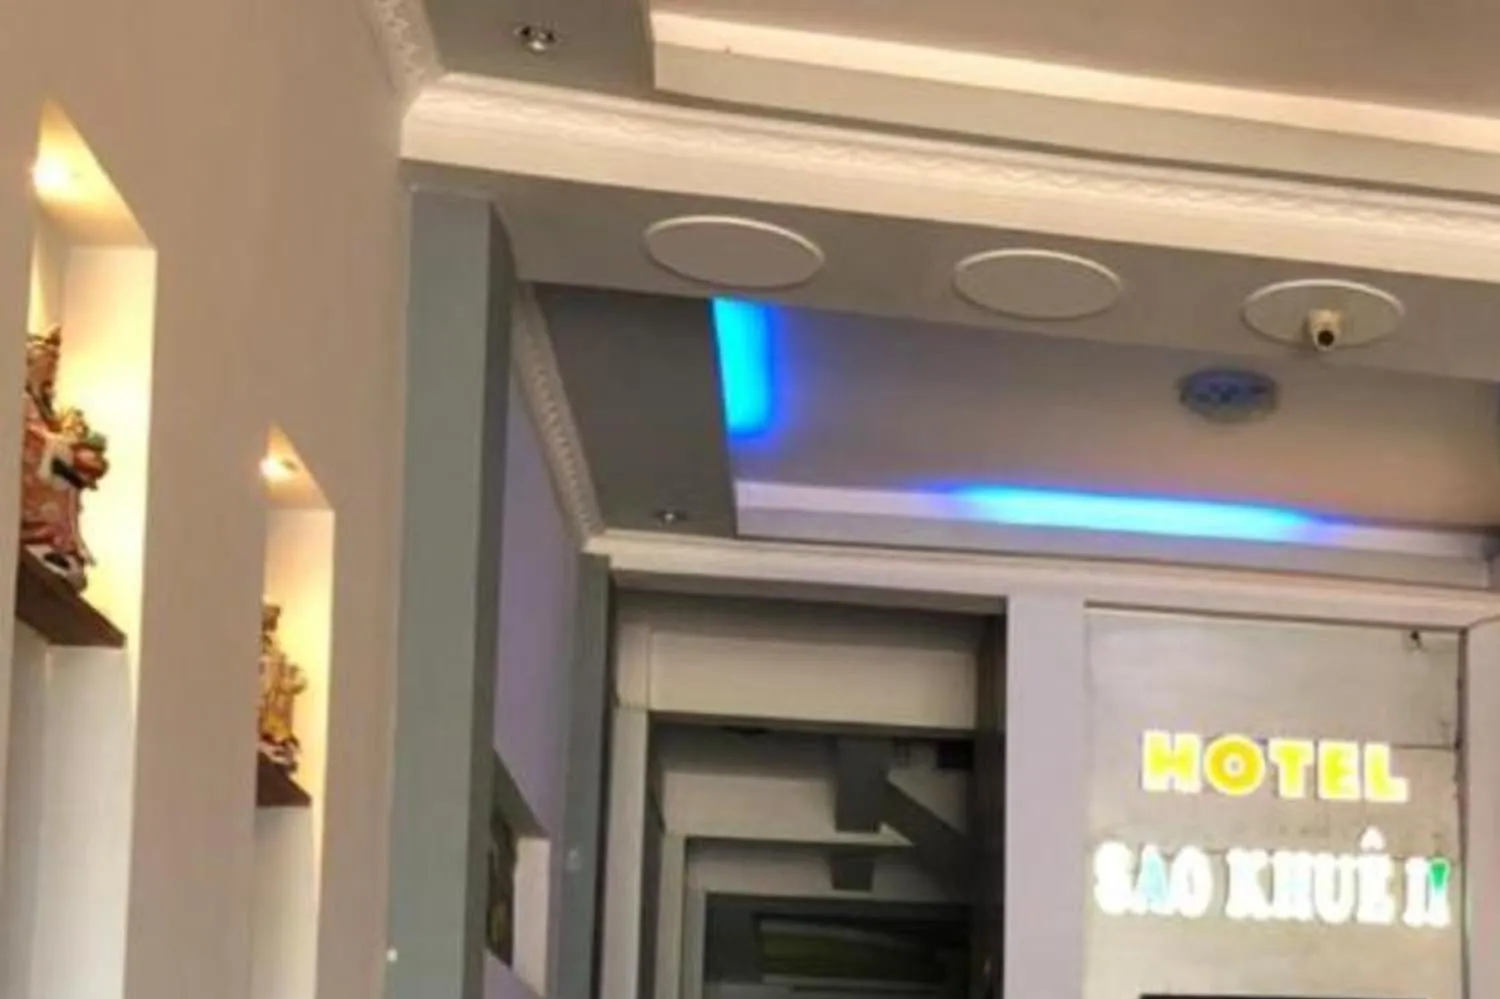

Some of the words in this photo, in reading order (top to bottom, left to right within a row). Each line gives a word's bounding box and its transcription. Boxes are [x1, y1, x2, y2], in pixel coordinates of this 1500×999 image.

[1141, 729, 1408, 802] HOTEL
[1094, 841, 1212, 917] SAO
[1225, 825, 1394, 924] KHUÊ
